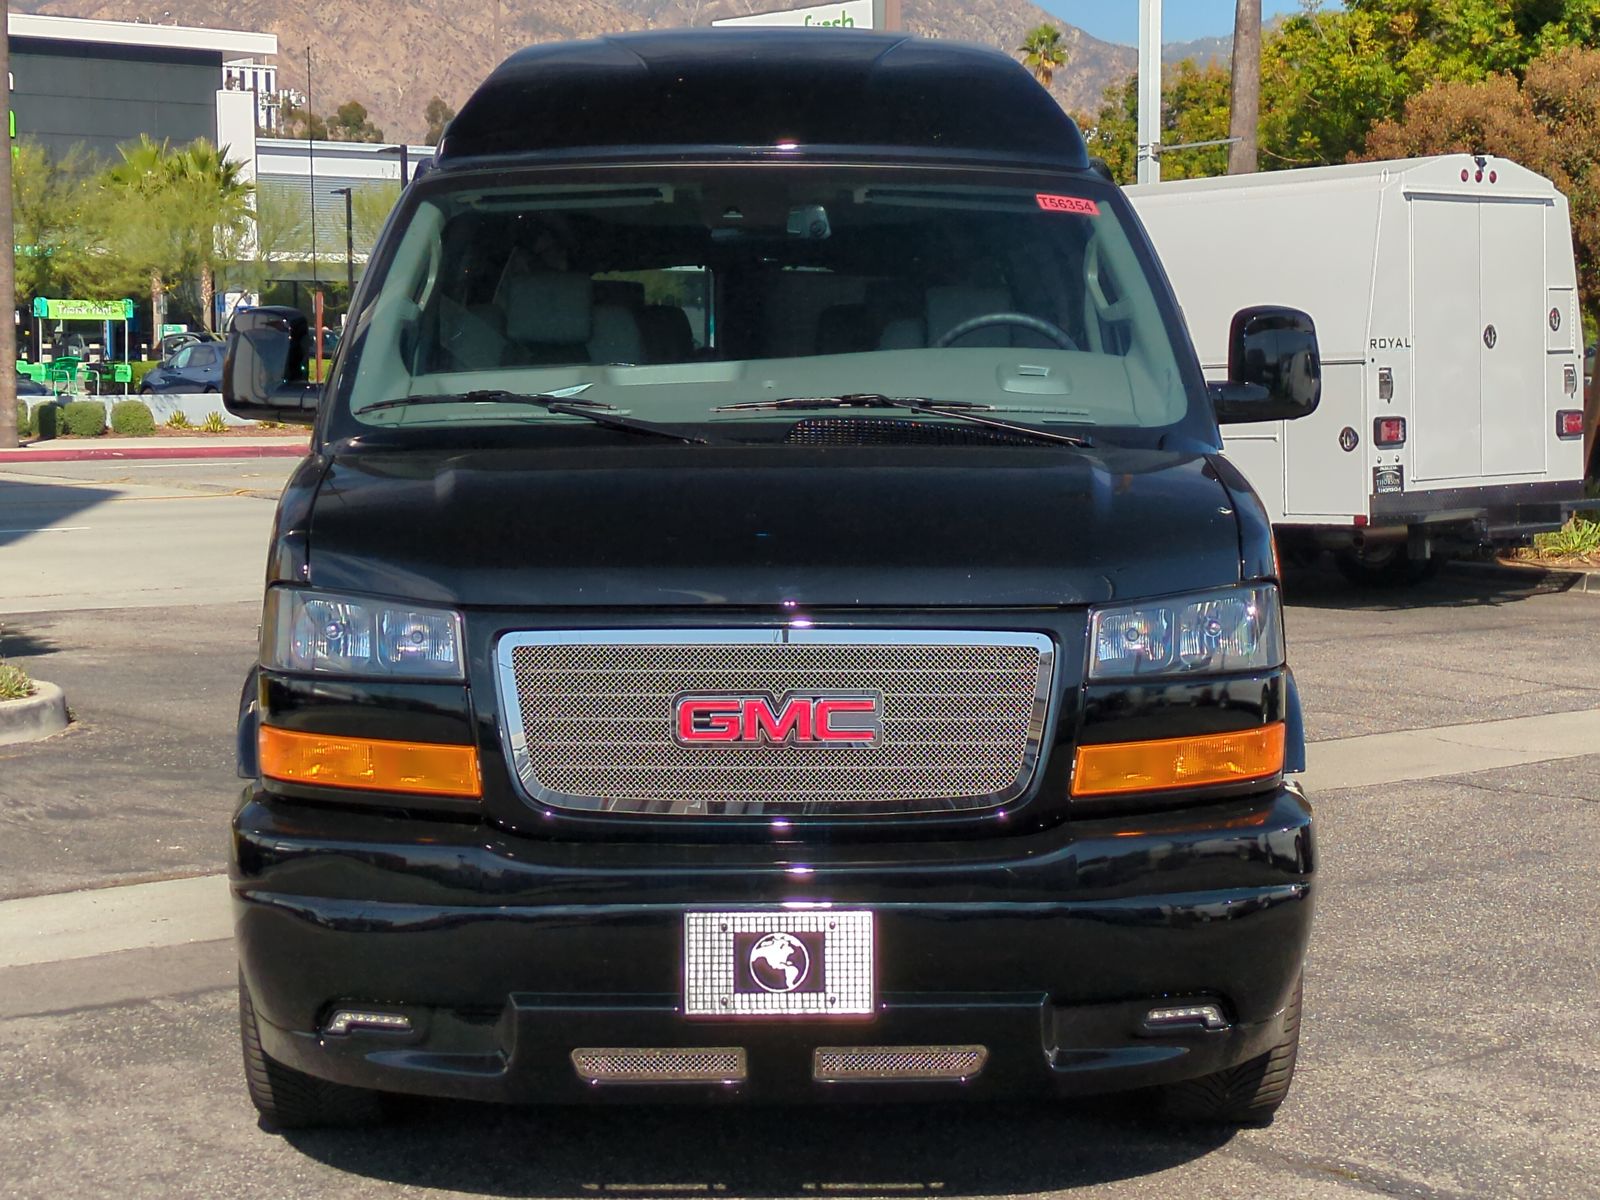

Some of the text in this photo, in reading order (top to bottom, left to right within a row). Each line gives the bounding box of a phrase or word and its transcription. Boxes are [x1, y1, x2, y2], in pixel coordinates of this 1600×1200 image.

[1037, 195, 1094, 212] T56354
[1369, 336, 1412, 349] ROYAL
[677, 697, 876, 742] GMC
